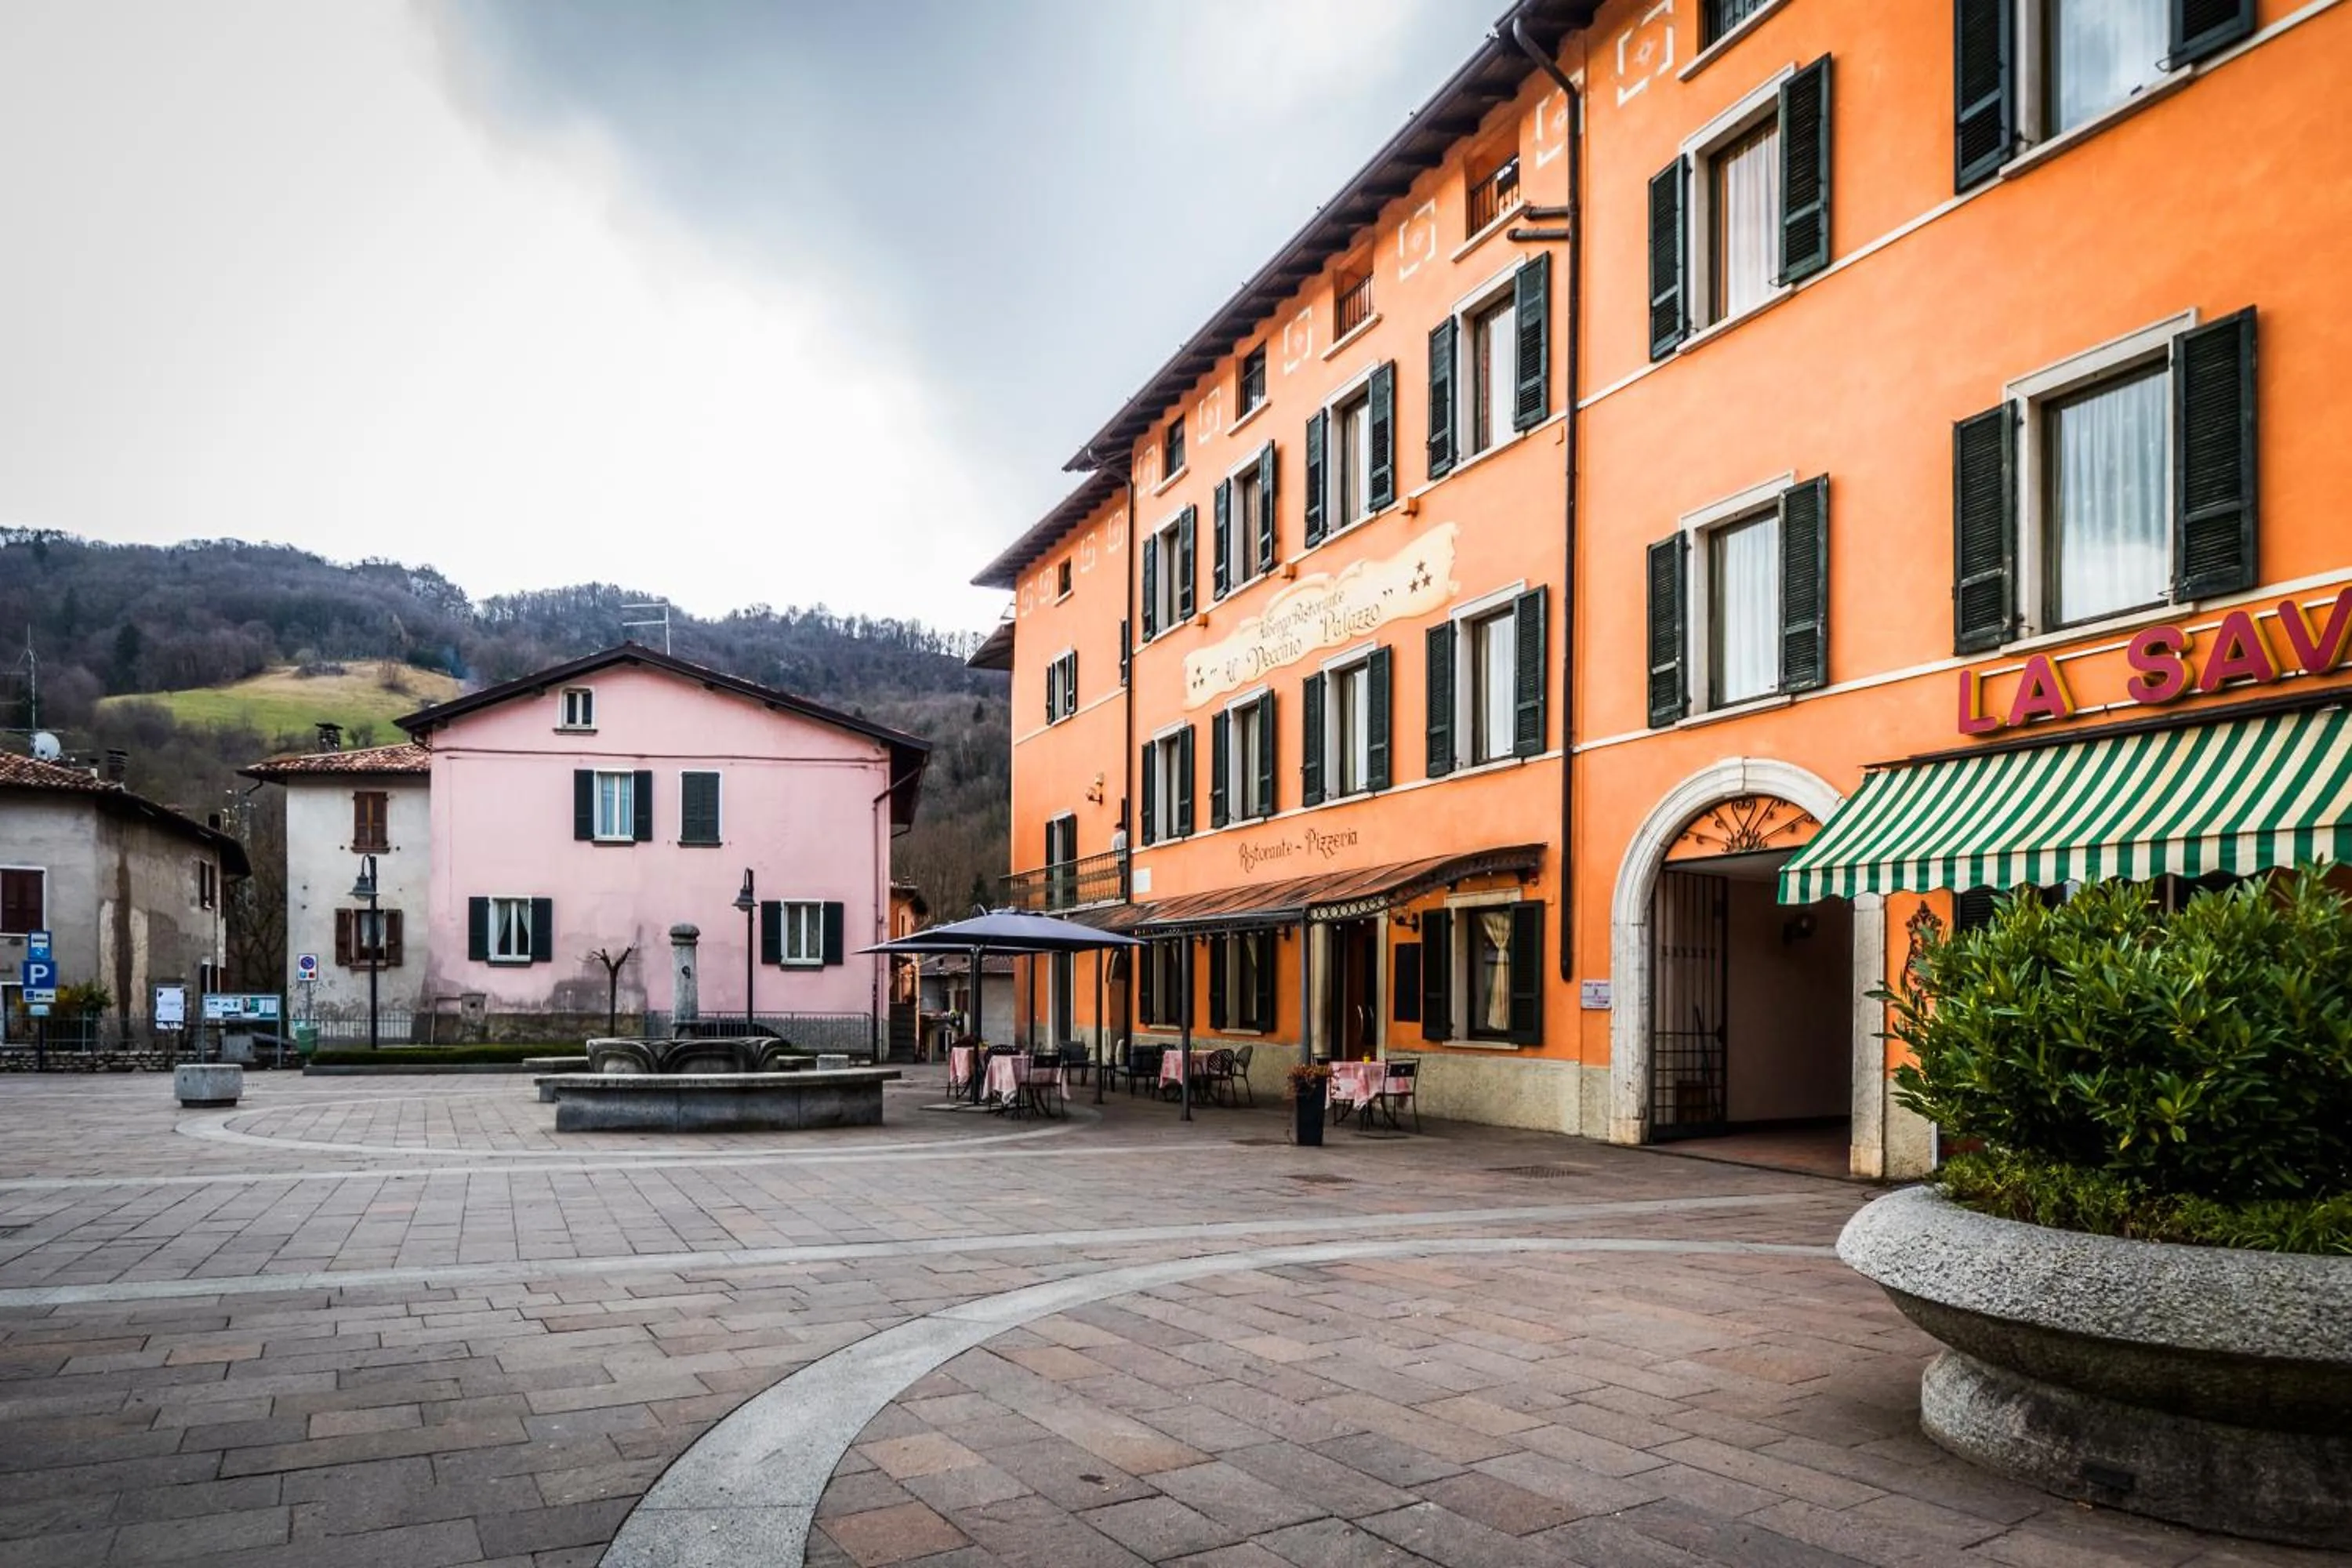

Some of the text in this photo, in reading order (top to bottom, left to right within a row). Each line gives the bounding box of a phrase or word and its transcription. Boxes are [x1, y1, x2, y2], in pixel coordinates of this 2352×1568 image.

[1319, 603, 1381, 643] Palazzo
[1958, 586, 2352, 735] LA SAV
[1305, 827, 1359, 859] Pizzeria
[29, 964, 49, 985] P
